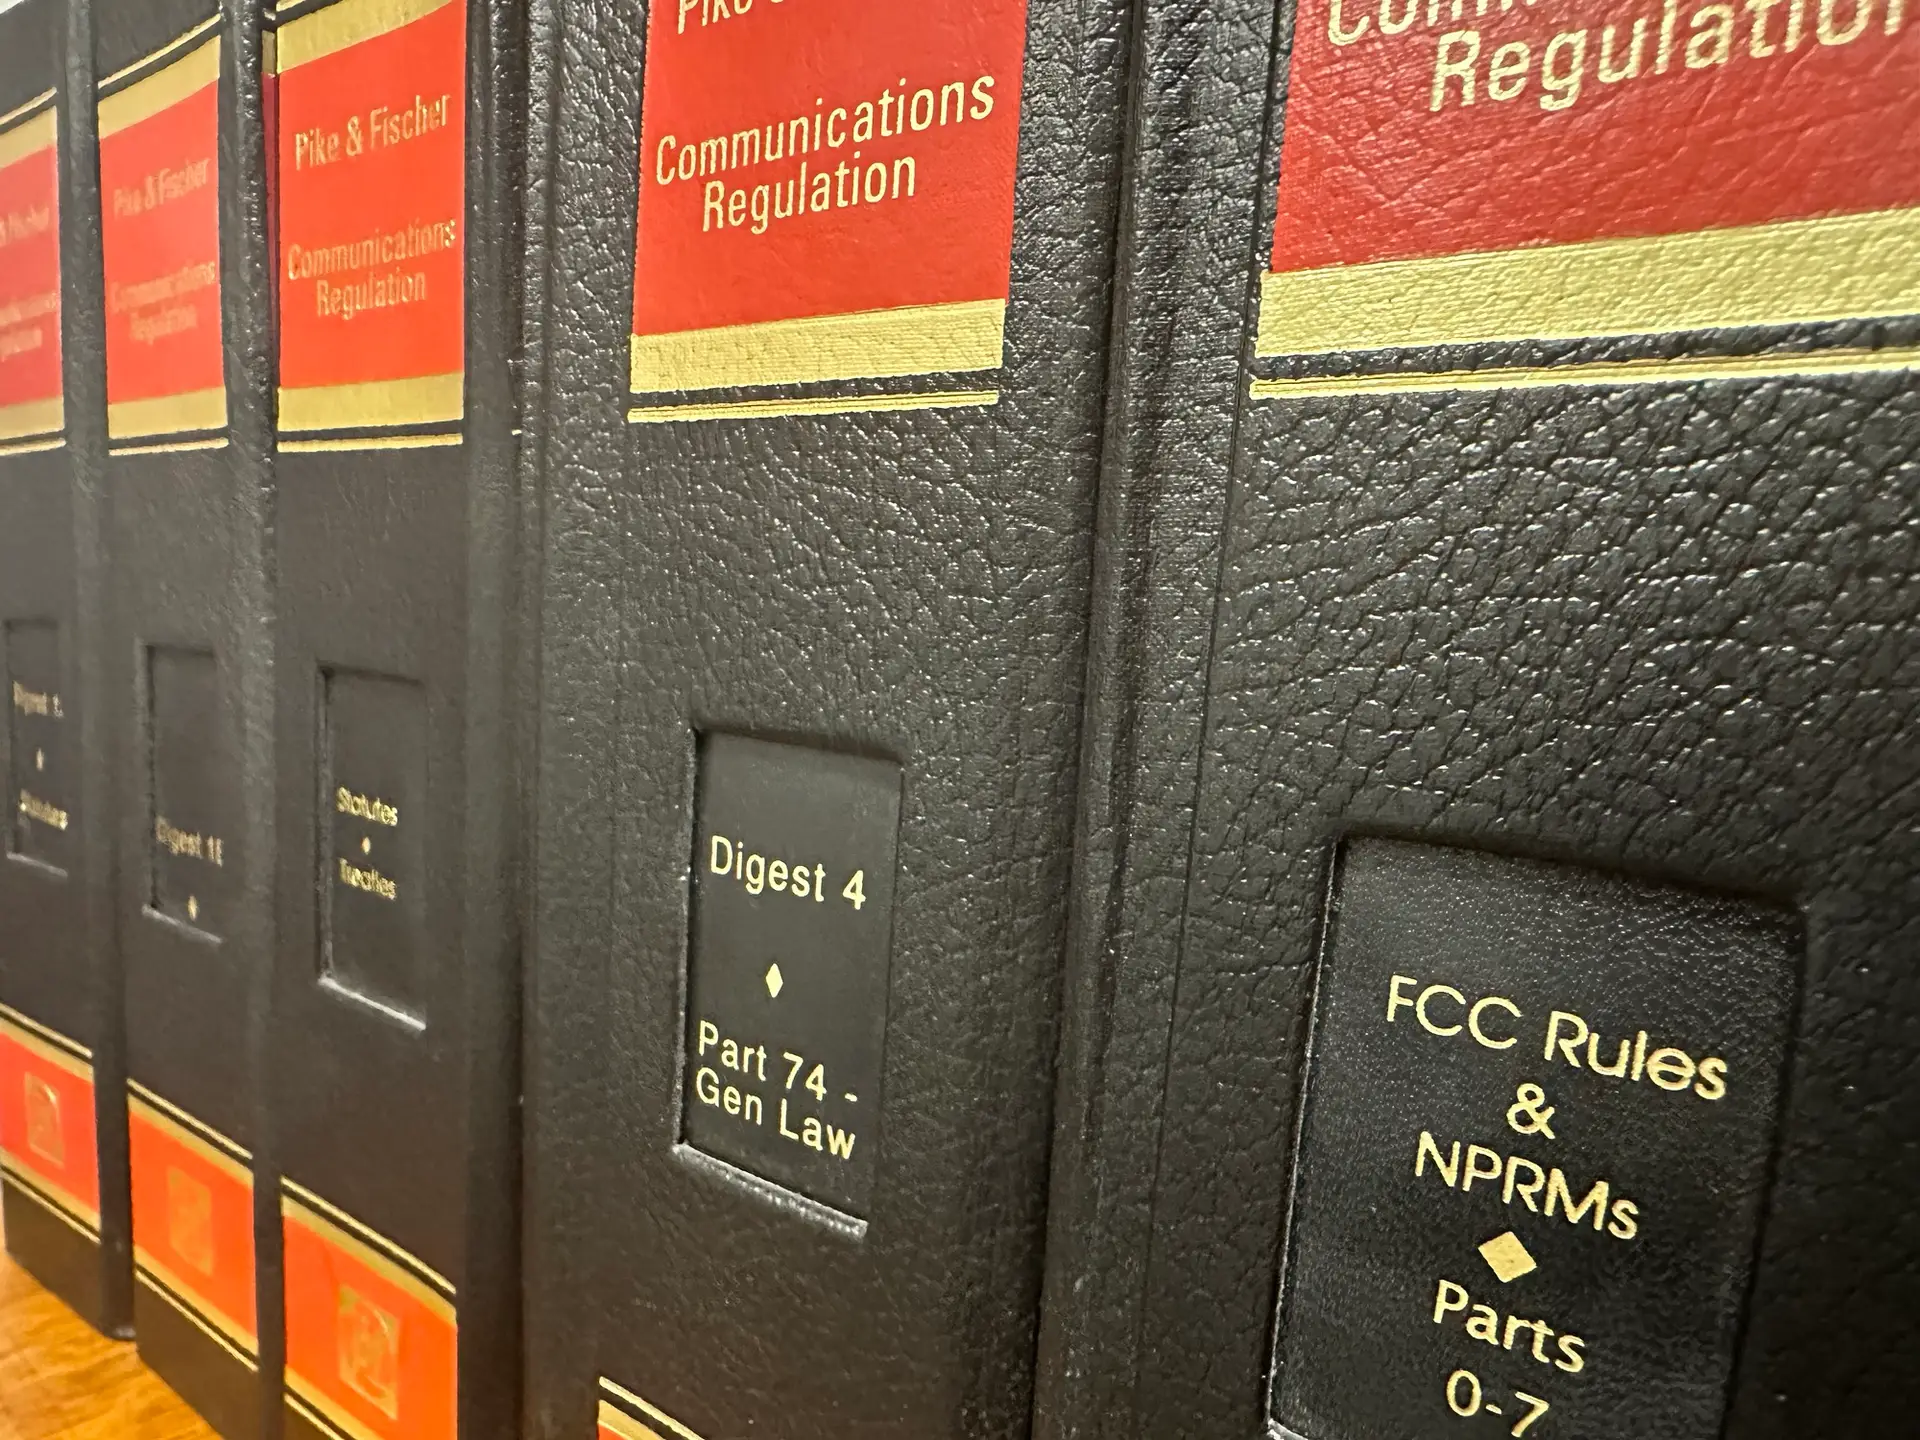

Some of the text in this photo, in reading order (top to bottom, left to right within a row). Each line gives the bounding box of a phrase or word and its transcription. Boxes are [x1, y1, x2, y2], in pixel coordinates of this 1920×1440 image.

[1430, 0, 1905, 112] Regulatio
[294, 93, 452, 171] Pike & Fischer
[655, 74, 996, 187] Communications
[701, 151, 917, 236] Regulation
[287, 217, 457, 281] Communications
[315, 266, 427, 321] Regulation
[337, 786, 399, 827] Statutes
[709, 834, 867, 911] Digest 4
[698, 1019, 768, 1082] Part
[782, 1051, 828, 1102] 74
[1386, 973, 1729, 1101] FCC Rules
[695, 1066, 857, 1161] Gen Law
[1505, 1082, 1556, 1140] &
[1414, 1130, 1640, 1241] NPRMs
[1432, 1278, 1587, 1374] Parts
[1445, 1369, 1551, 1439] 0-7
